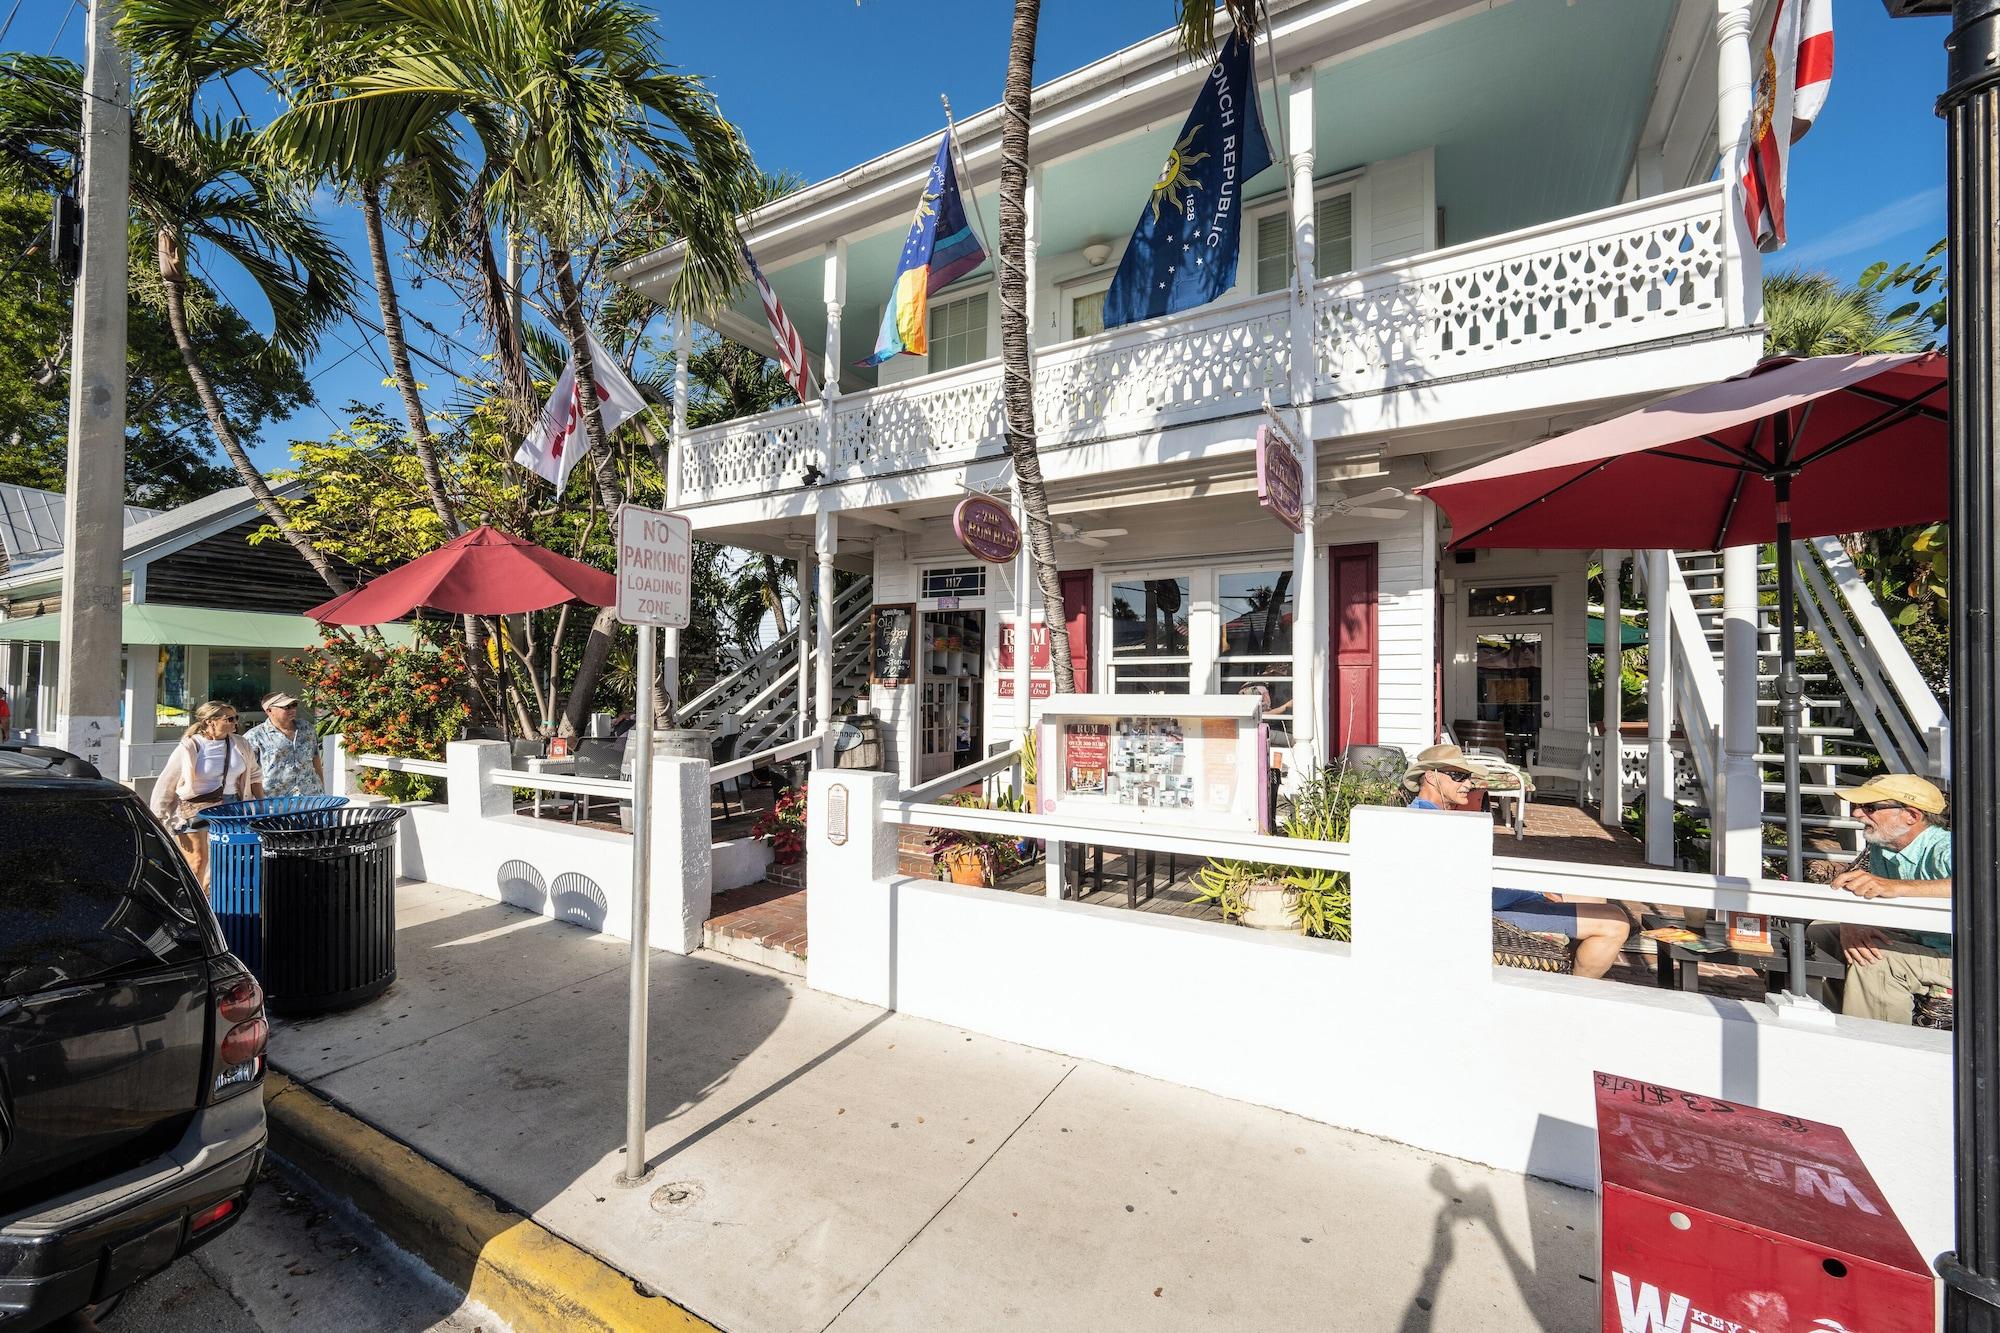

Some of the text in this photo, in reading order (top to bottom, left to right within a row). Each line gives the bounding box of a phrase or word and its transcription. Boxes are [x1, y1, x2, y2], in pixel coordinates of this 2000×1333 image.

[1206, 61, 1236, 248] ONCH REPUBLIC
[1186, 193, 1195, 222] 1828
[643, 520, 669, 544] NO
[624, 545, 686, 575] PARKING
[627, 574, 682, 595] LOADING
[945, 577, 962, 588] 1117
[638, 598, 671, 616] ZONE
[1003, 628, 1046, 646] RM
[1077, 724, 1098, 734] RUM
[348, 841, 378, 854] Trash
[1691, 1308, 1742, 1333] KEY
